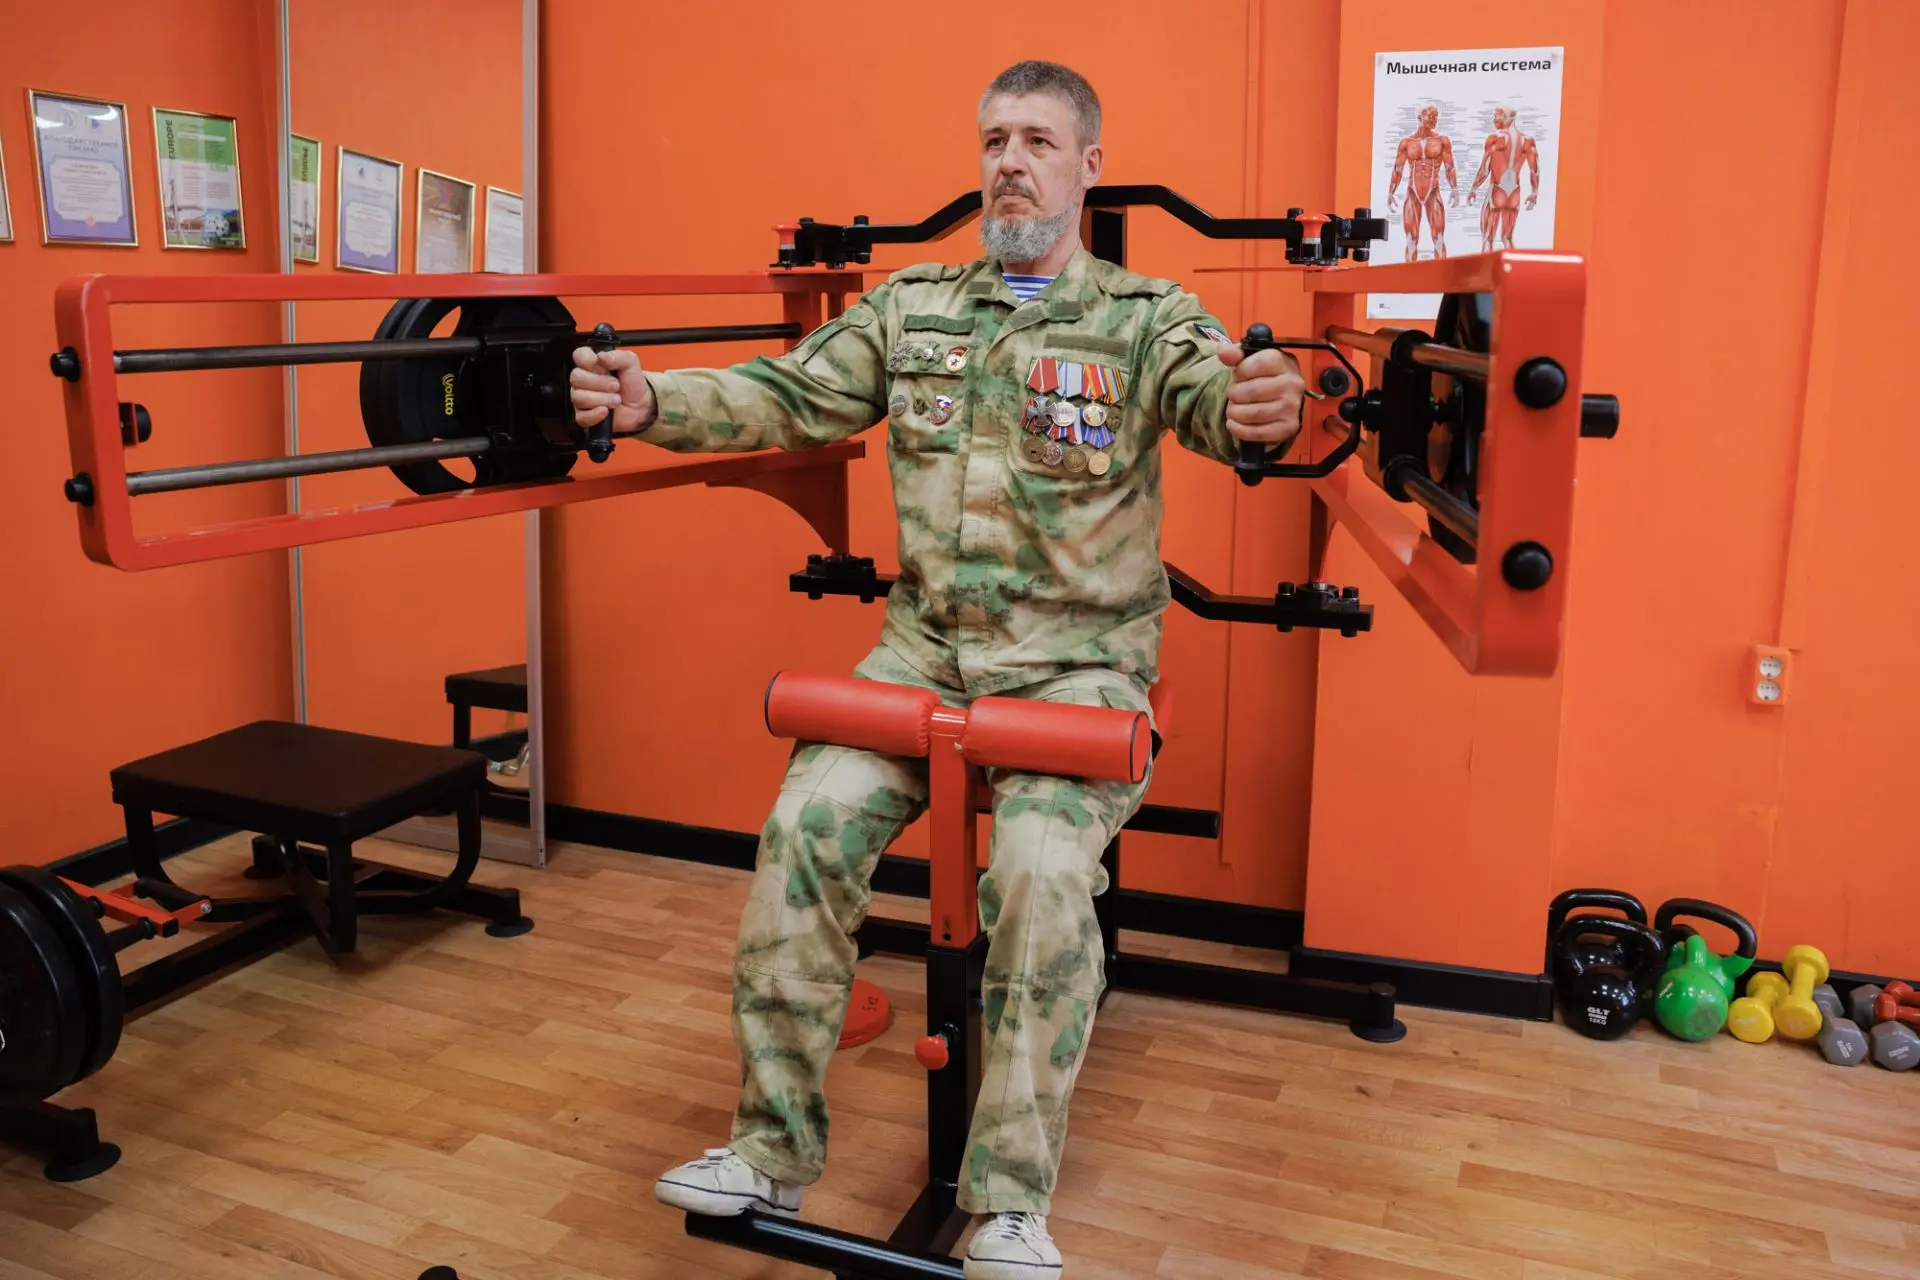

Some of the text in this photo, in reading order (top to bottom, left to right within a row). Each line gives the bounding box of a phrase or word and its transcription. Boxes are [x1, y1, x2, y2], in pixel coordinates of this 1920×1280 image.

[1386, 59, 1552, 75] Мышечная система
[165, 119, 176, 160] EUROPE
[443, 374, 454, 415] Voltto
[1587, 1006, 1610, 1016] GLT
